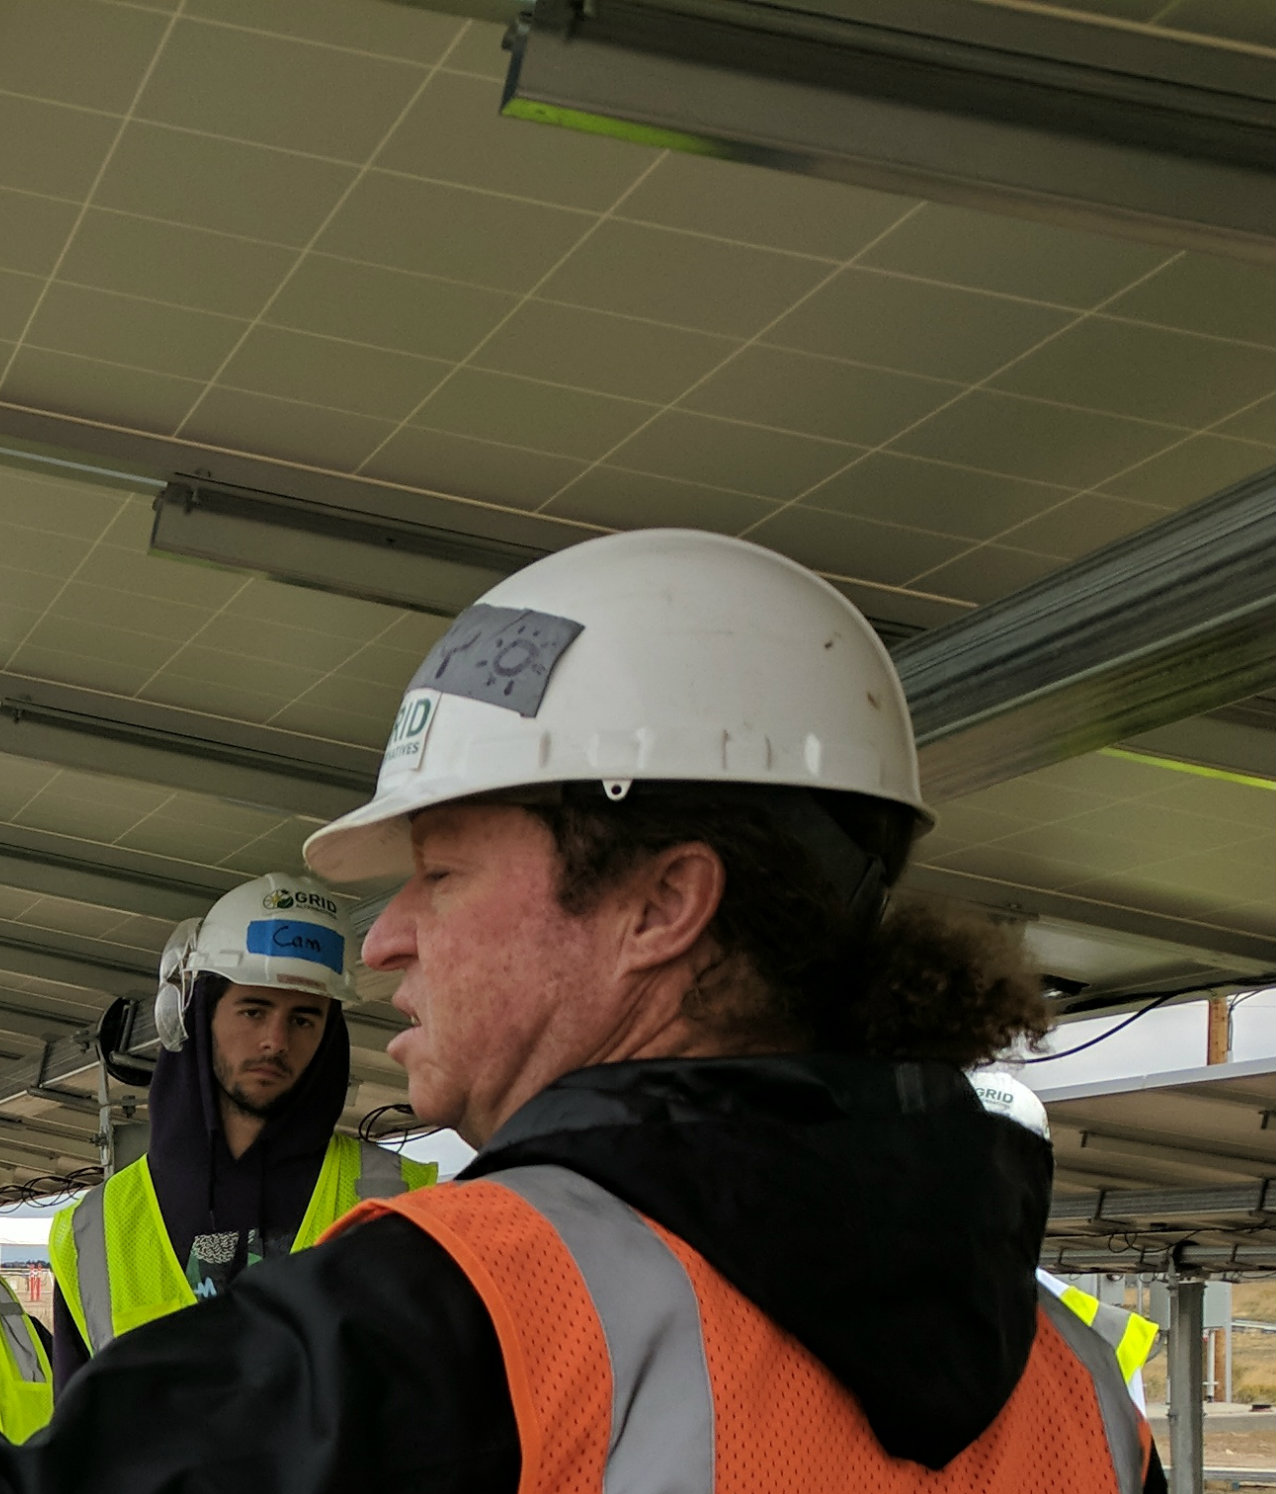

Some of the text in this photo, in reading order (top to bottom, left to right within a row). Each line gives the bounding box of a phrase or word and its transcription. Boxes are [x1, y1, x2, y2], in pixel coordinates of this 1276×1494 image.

[295, 891, 337, 914] GRID
[273, 925, 321, 952] Cam
[975, 1087, 1014, 1104] GRID
